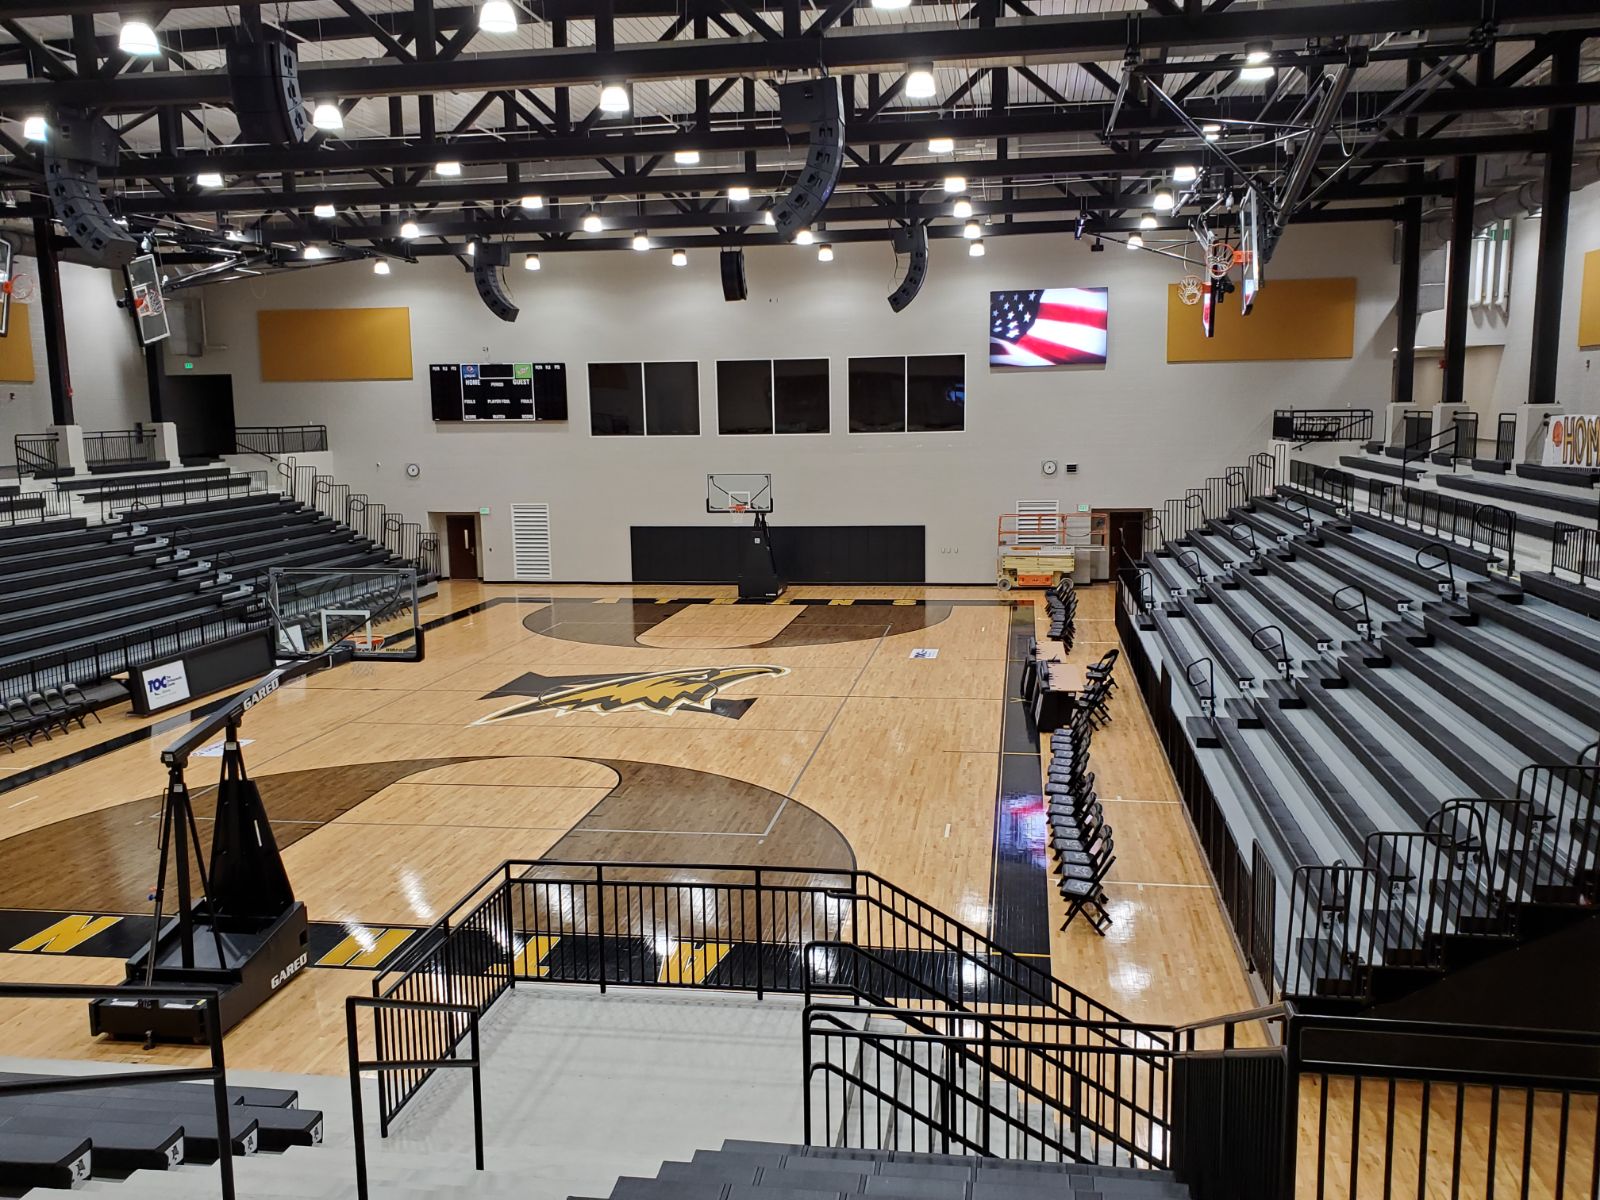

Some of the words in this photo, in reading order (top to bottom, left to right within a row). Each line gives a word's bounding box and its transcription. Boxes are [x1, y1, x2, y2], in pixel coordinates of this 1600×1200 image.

[148, 675, 168, 693] TOC
[243, 677, 280, 711] GARED
[271, 951, 308, 990] GARED
